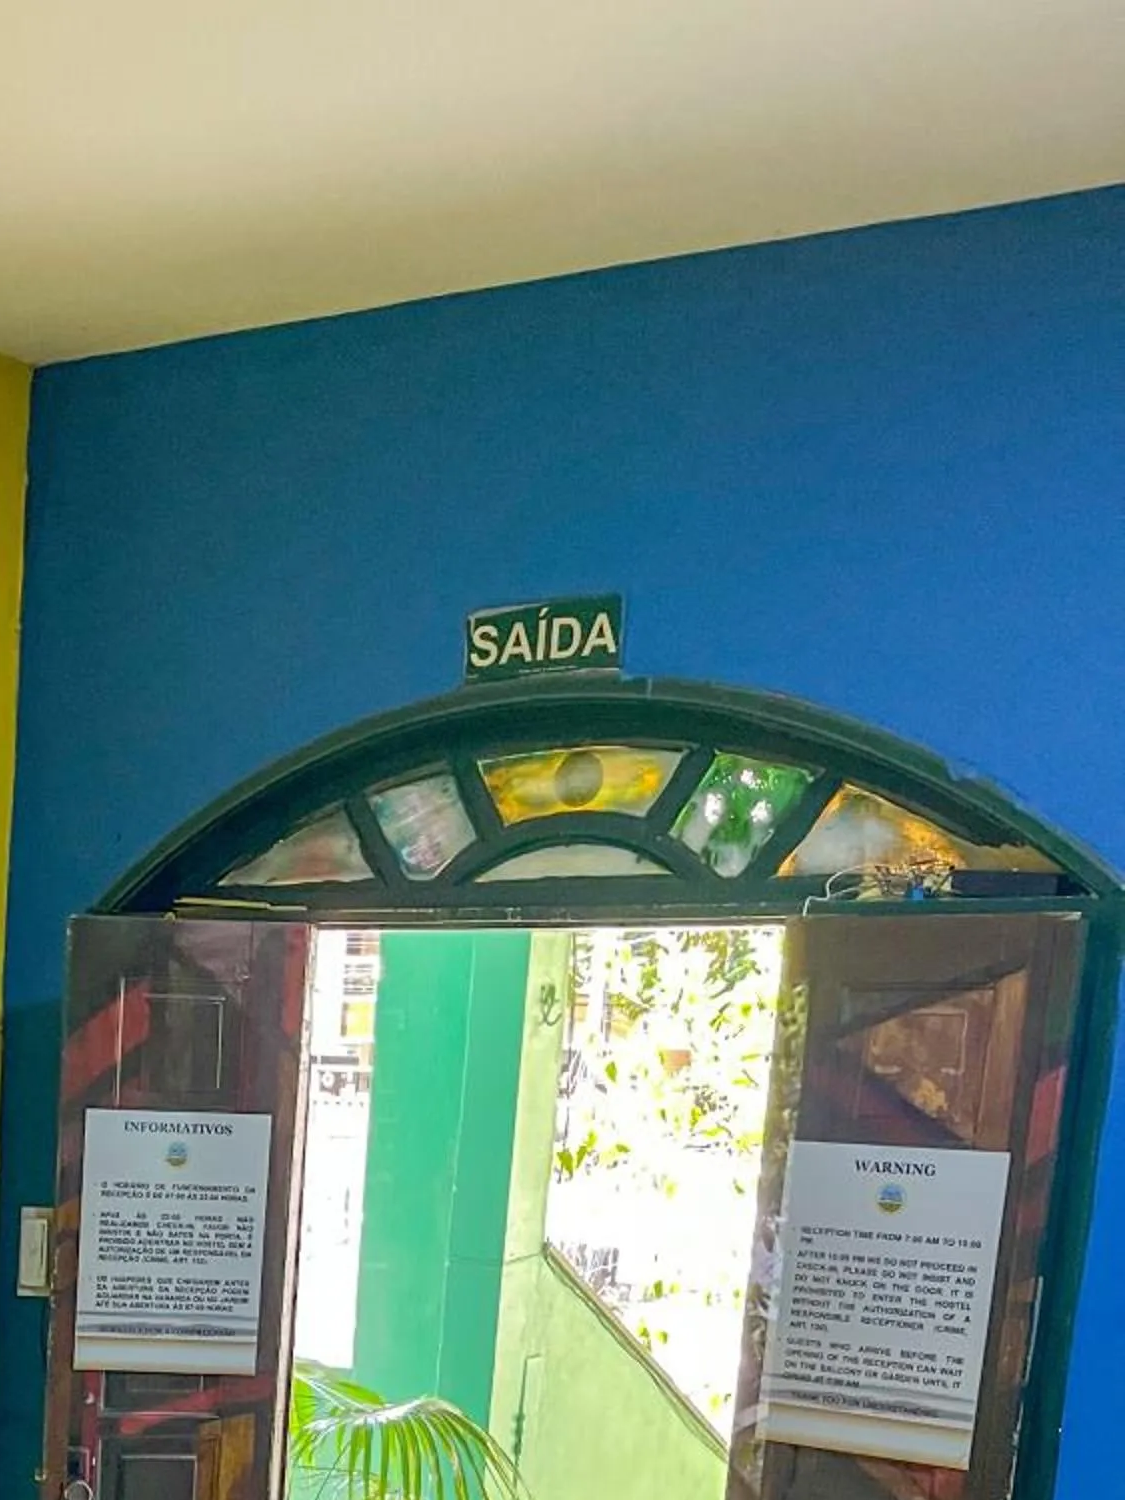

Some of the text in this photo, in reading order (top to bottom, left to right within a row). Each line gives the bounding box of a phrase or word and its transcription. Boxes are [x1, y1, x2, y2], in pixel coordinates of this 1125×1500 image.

[470, 607, 617, 667] SAÍDA
[125, 1121, 233, 1137] INFORMATIVOS
[855, 1159, 936, 1177] WARNING
[801, 1226, 851, 1238] RECEPTION
[854, 1230, 873, 1240] TIME
[876, 1232, 902, 1242] FROM
[925, 1236, 940, 1245] AM
[797, 1250, 826, 1259] AFTER
[883, 1258, 897, 1266] DO
[899, 1259, 917, 1268] NOT
[920, 1261, 965, 1272] PROCEED
[794, 1273, 807, 1281] DO
[892, 1283, 910, 1292] THE
[843, 1266, 878, 1277] PLEASE
[882, 1270, 896, 1278] DO
[898, 1272, 917, 1280] NOT
[955, 1277, 976, 1286] AND
[872, 1294, 902, 1304] ENTER
[909, 1298, 927, 1307] THE
[784, 1359, 797, 1368] ON
[800, 1362, 816, 1370] THE
[842, 1355, 859, 1364] THE
[862, 1358, 914, 1371] RECEPTION
[916, 1365, 936, 1374] CAN
[940, 1368, 963, 1378] WAIT
[900, 1350, 937, 1362] BEFORE
[946, 1356, 965, 1365] THE
